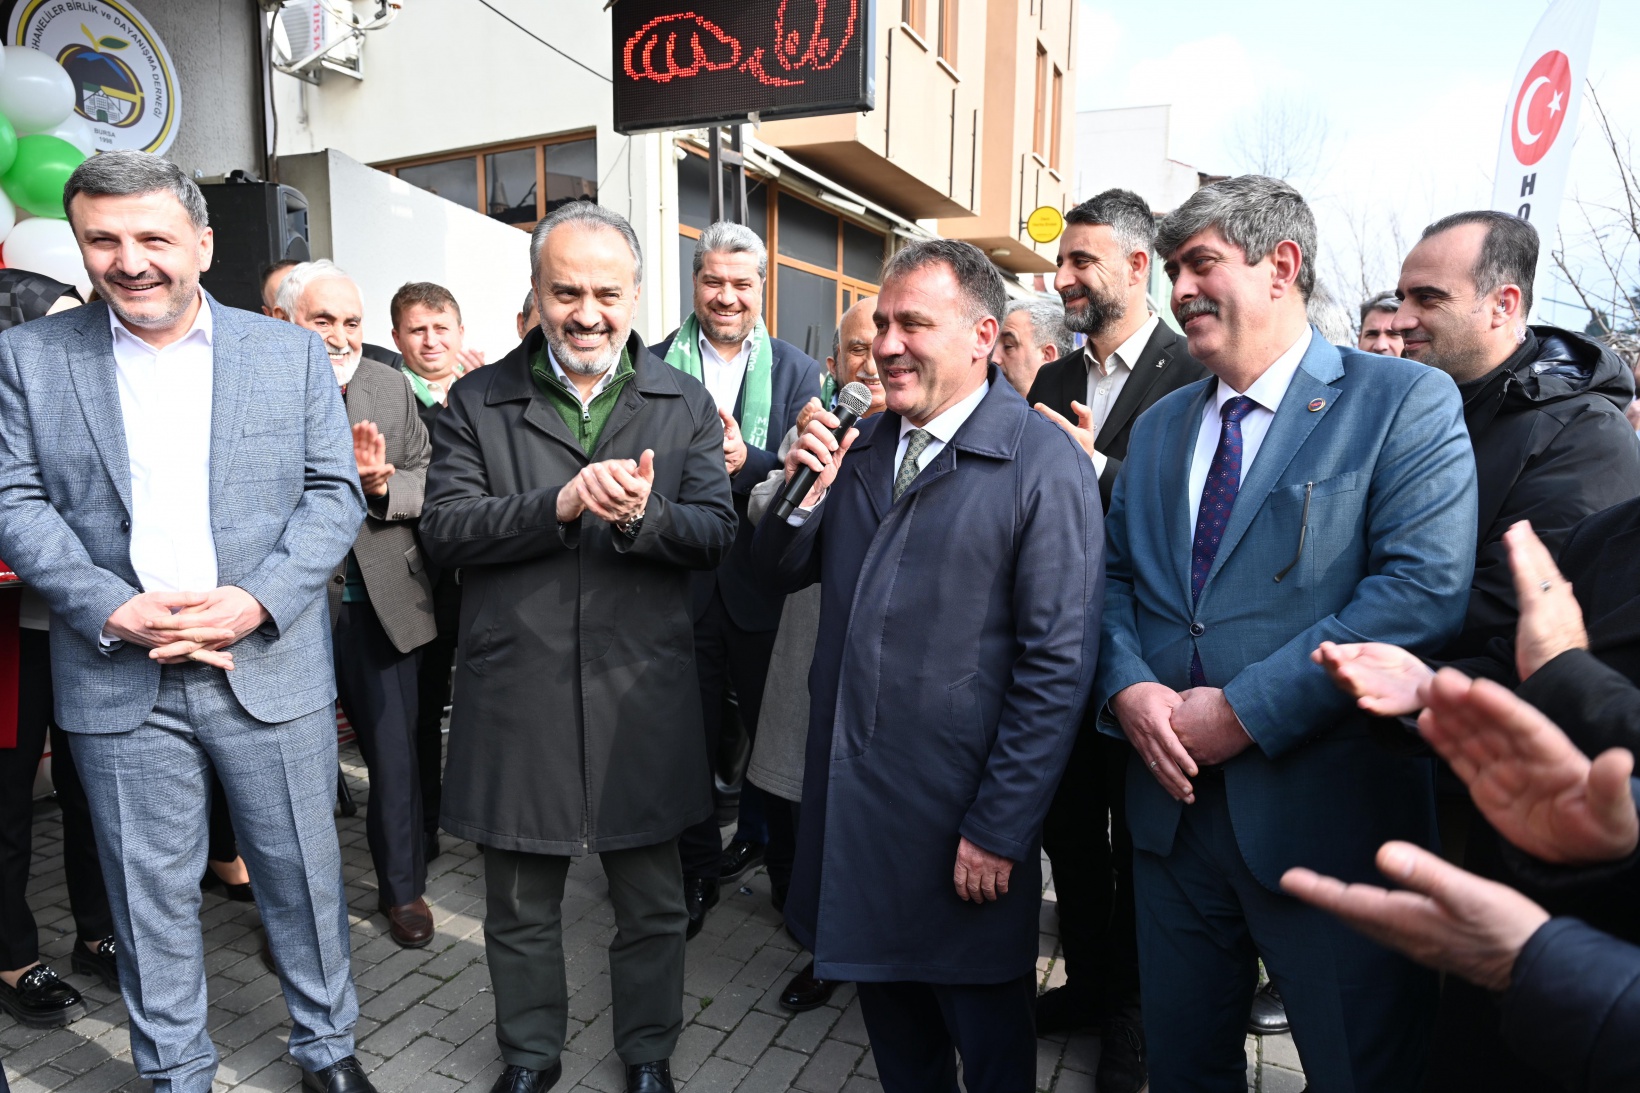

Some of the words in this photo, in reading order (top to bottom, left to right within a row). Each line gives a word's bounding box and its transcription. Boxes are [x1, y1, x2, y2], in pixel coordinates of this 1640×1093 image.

[66, 0, 98, 14] BİRLİK
[101, 10, 111, 20] ve
[113, 16, 157, 71] DAYANIŞMA
[152, 73, 163, 119] DERNEĞİ
[94, 127, 116, 138] BURSA
